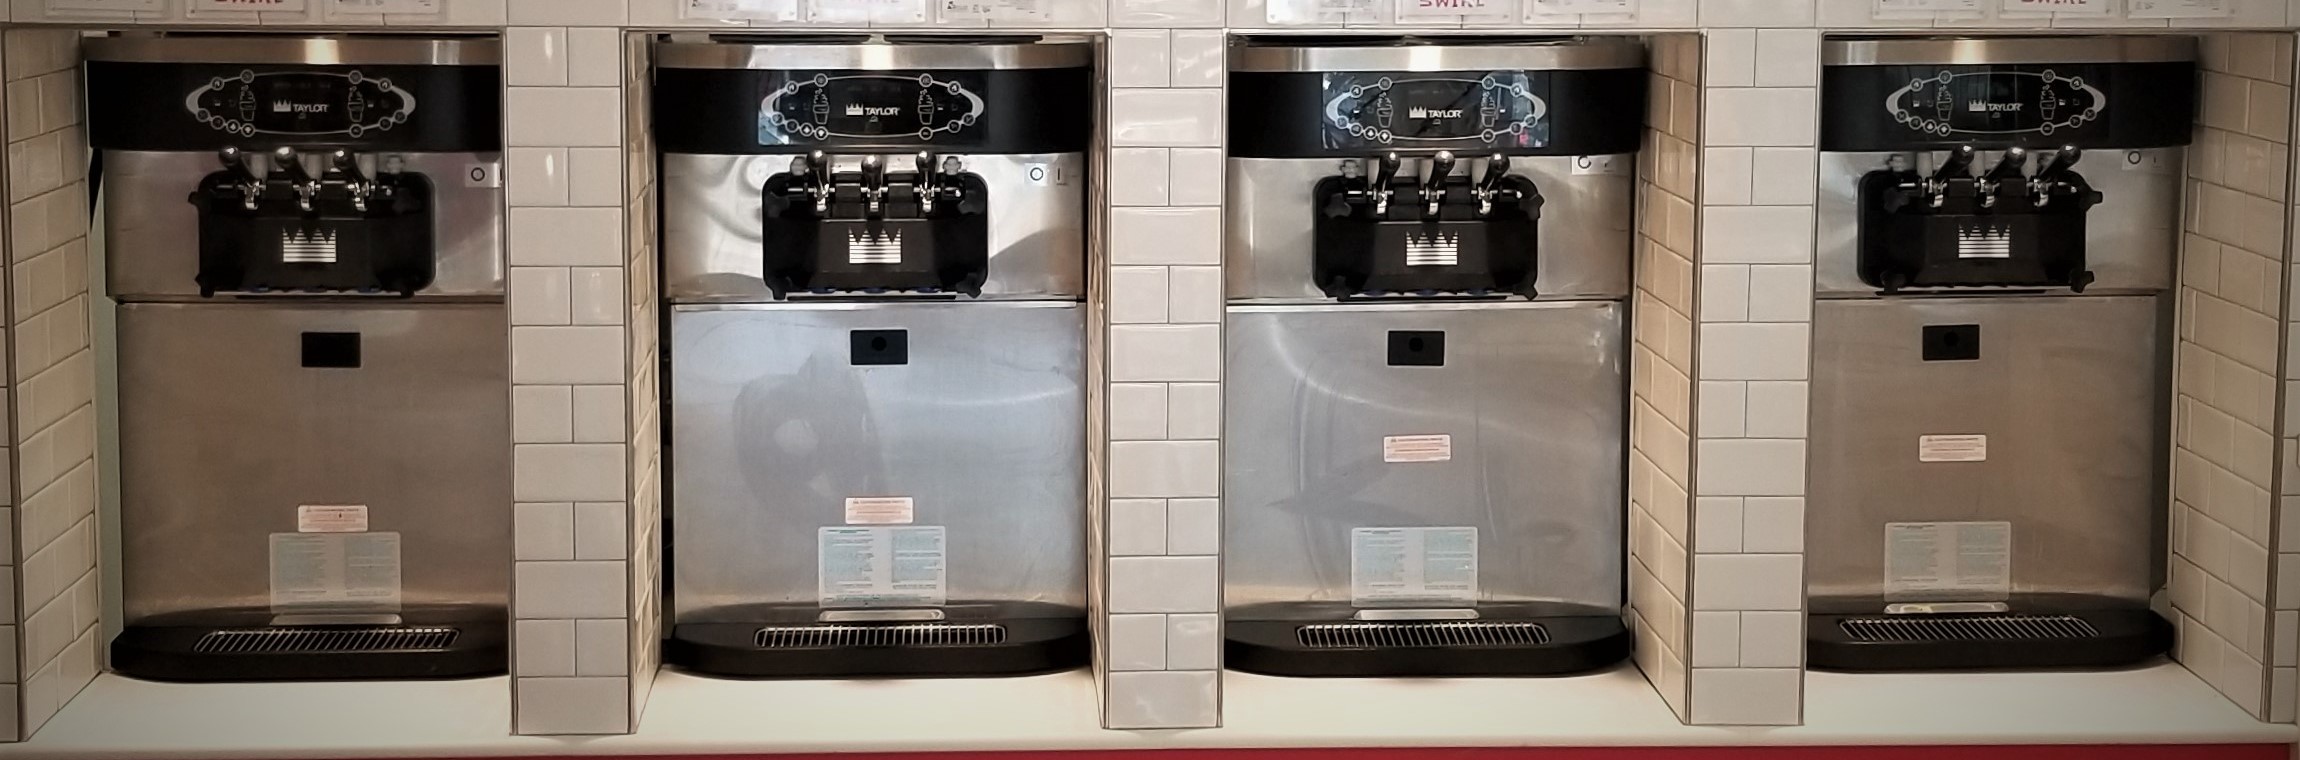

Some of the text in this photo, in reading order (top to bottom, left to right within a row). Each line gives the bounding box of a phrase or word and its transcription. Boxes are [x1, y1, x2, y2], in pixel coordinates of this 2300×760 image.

[293, 104, 328, 112] TAYLOR
[1987, 103, 2022, 111] TAYLOR
[865, 107, 899, 116] TAYLOR
[1428, 110, 1462, 118] TAYLOR
